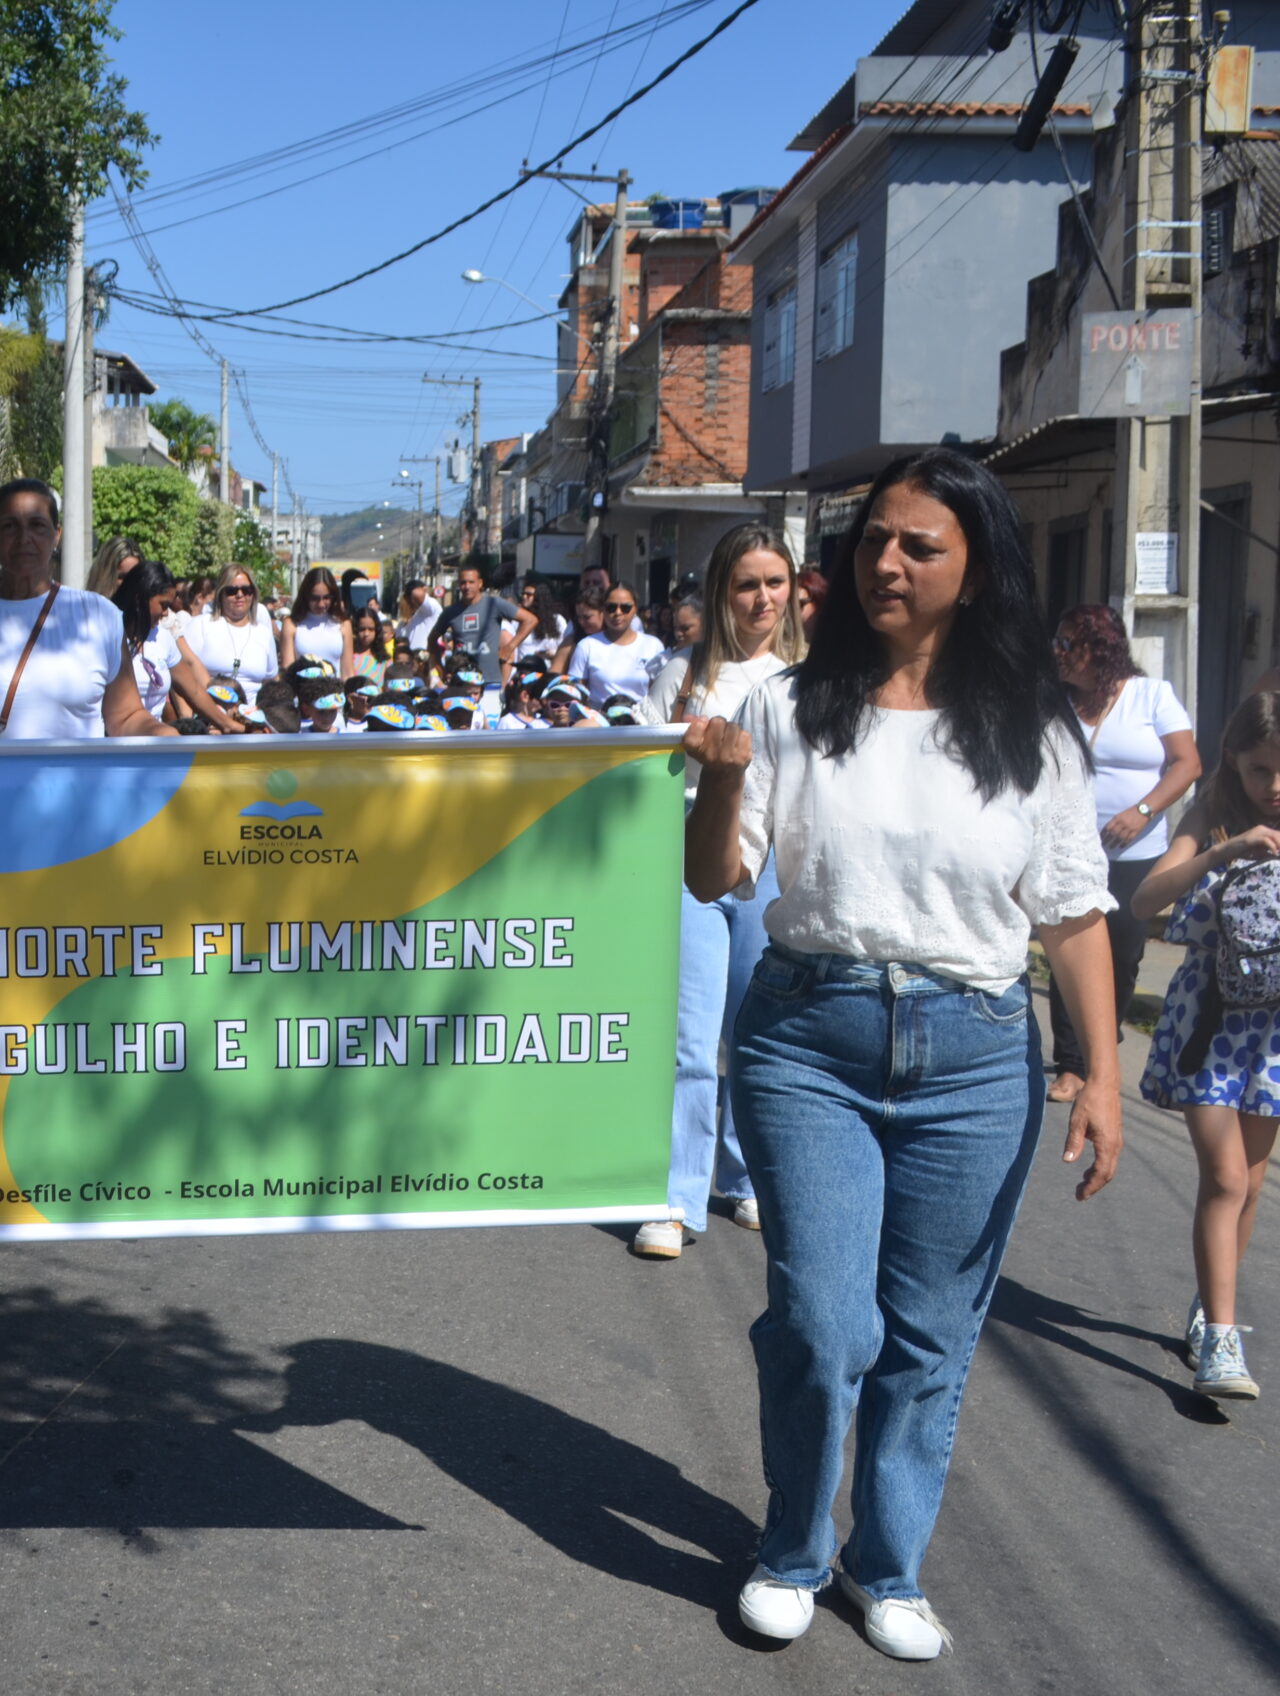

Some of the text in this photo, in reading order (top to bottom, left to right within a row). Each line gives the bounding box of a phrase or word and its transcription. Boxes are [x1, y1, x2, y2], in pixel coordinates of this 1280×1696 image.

[1090, 322, 1180, 352] PONTE
[240, 825, 323, 840] ESCOLA
[203, 846, 359, 865] ELVÍDIO COSTA
[192, 916, 575, 976] FLUMINENSE
[214, 1018, 249, 1072] E
[274, 1011, 630, 1070] IDENTIDADE
[79, 1181, 151, 1201] Cívico
[180, 1179, 255, 1199] Escola
[263, 1175, 382, 1200] Municipal
[390, 1172, 470, 1193] Elvídio
[477, 1172, 545, 1190] Costa
